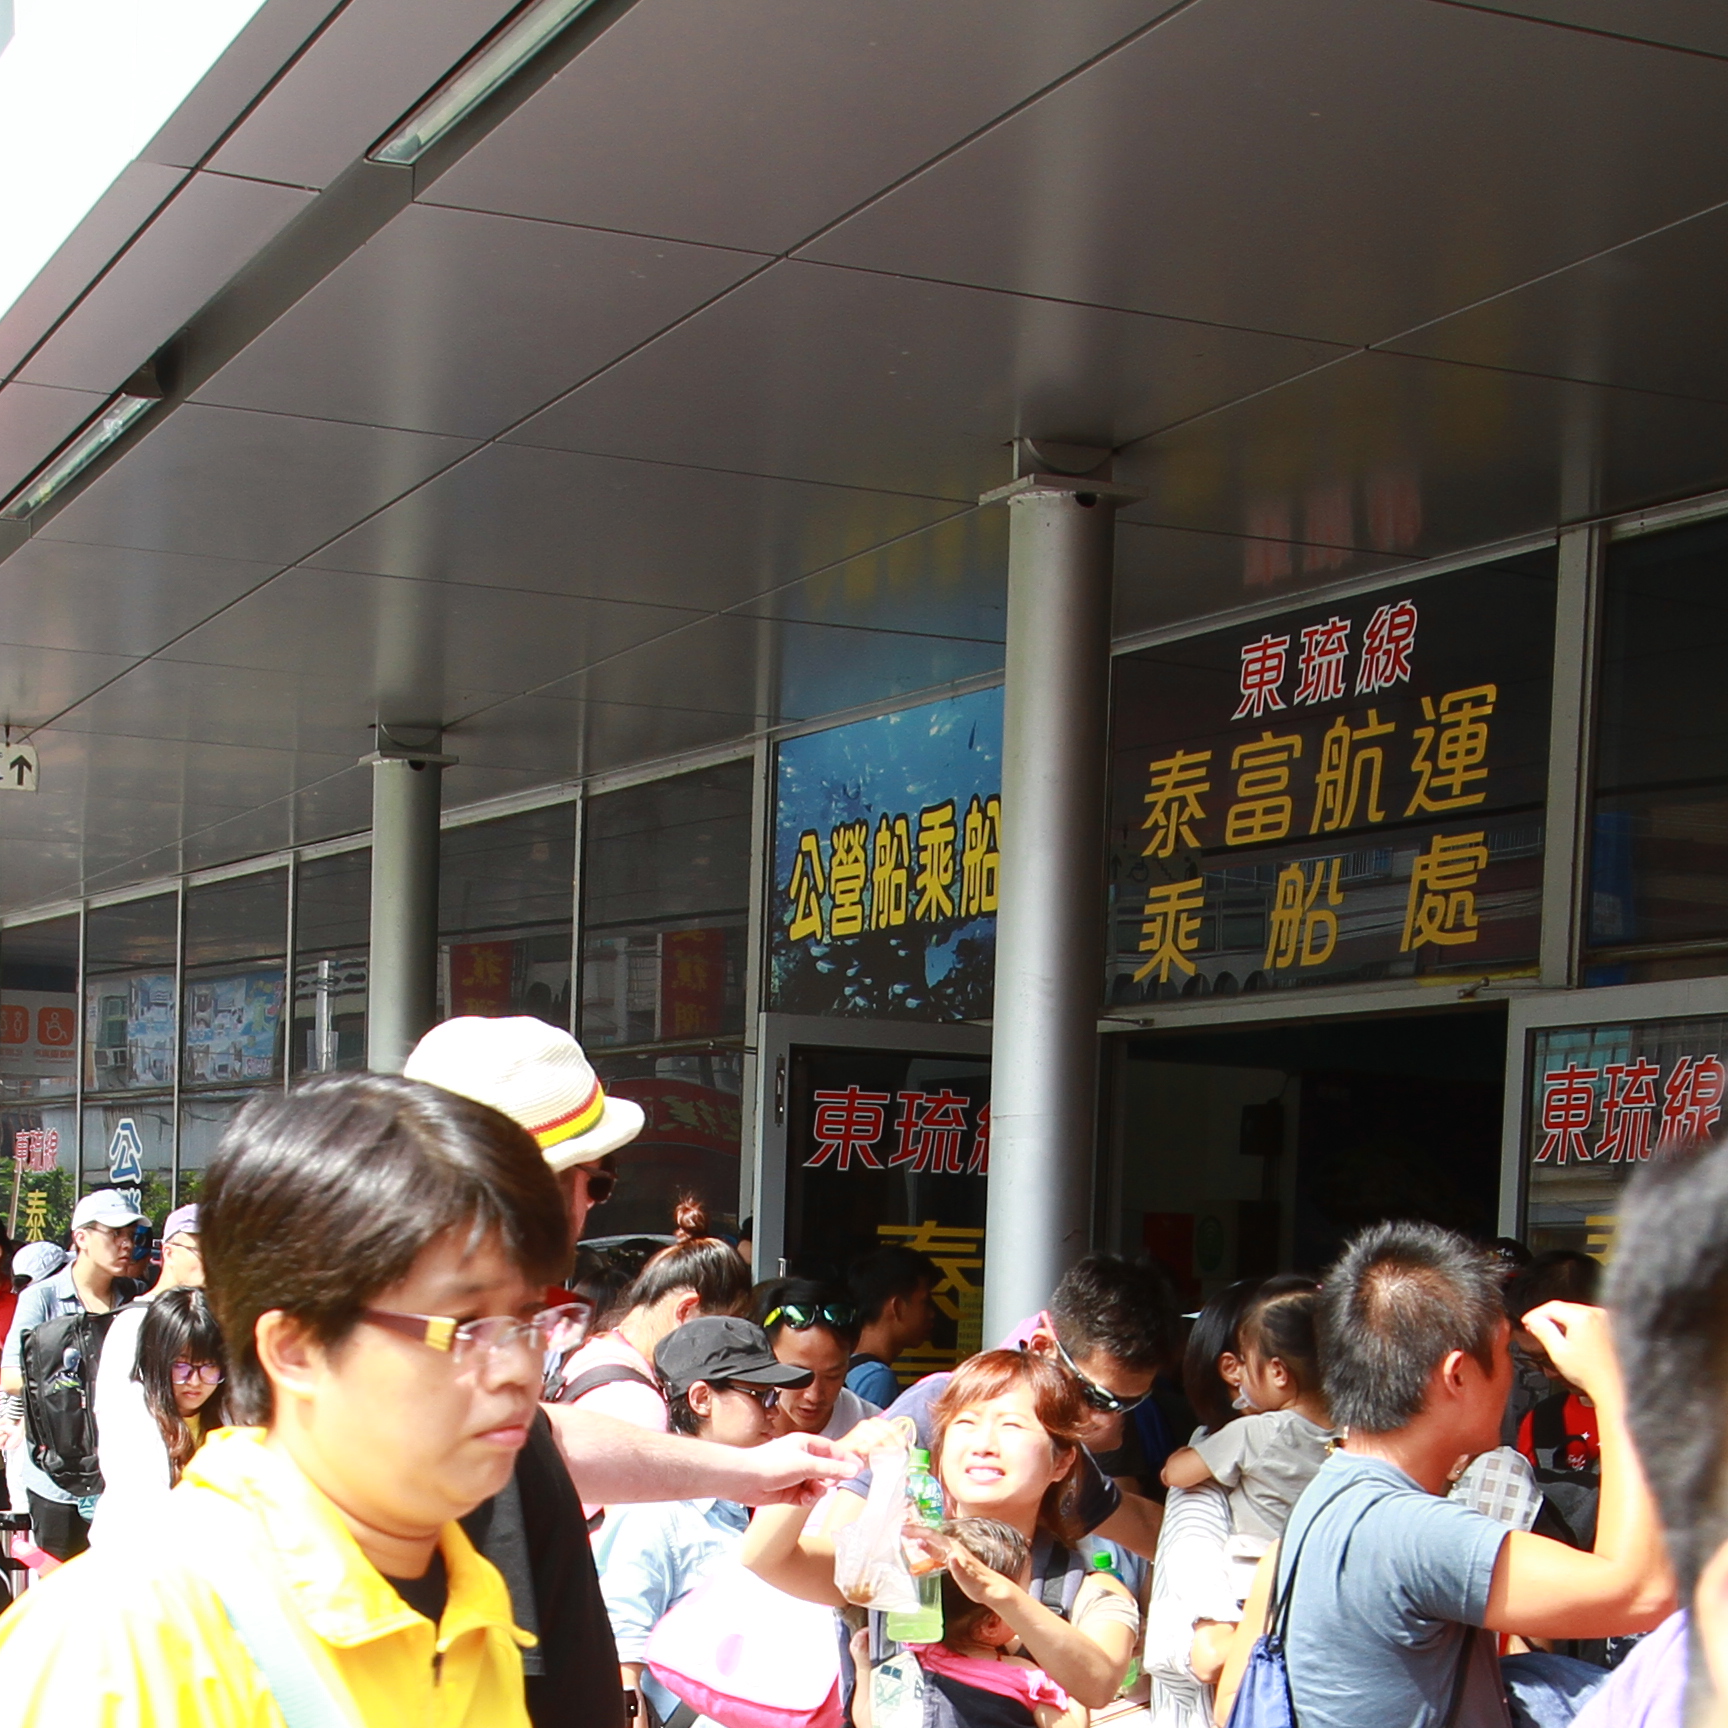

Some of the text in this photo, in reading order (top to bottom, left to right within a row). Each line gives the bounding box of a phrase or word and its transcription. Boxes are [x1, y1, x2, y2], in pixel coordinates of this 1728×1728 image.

[1230, 597, 1419, 722] 東琉線
[1141, 683, 1498, 858] 泰富航運
[787, 792, 1002, 944] 公營船乘船
[1133, 831, 1489, 984] 乘船處
[802, 1085, 990, 1175] 東琉
[1534, 1052, 1728, 1166] 東琉線
